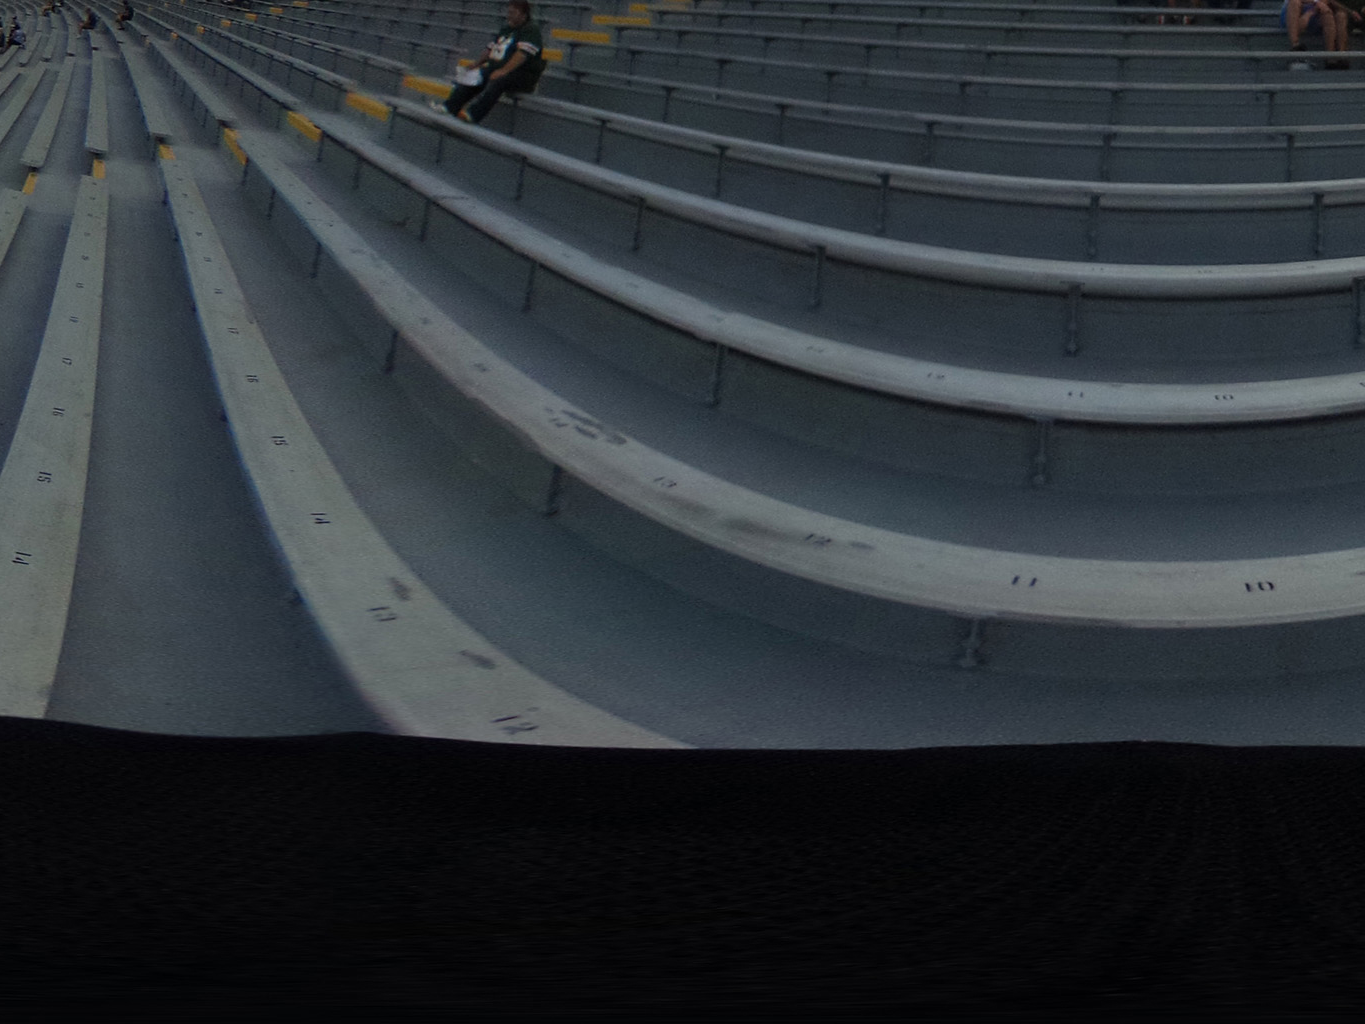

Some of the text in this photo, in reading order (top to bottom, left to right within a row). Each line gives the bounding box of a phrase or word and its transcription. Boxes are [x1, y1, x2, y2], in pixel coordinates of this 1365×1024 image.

[36, 470, 53, 484] 15
[11, 551, 32, 566] 14
[1011, 575, 1038, 588] 11
[1244, 581, 1275, 593] 10
